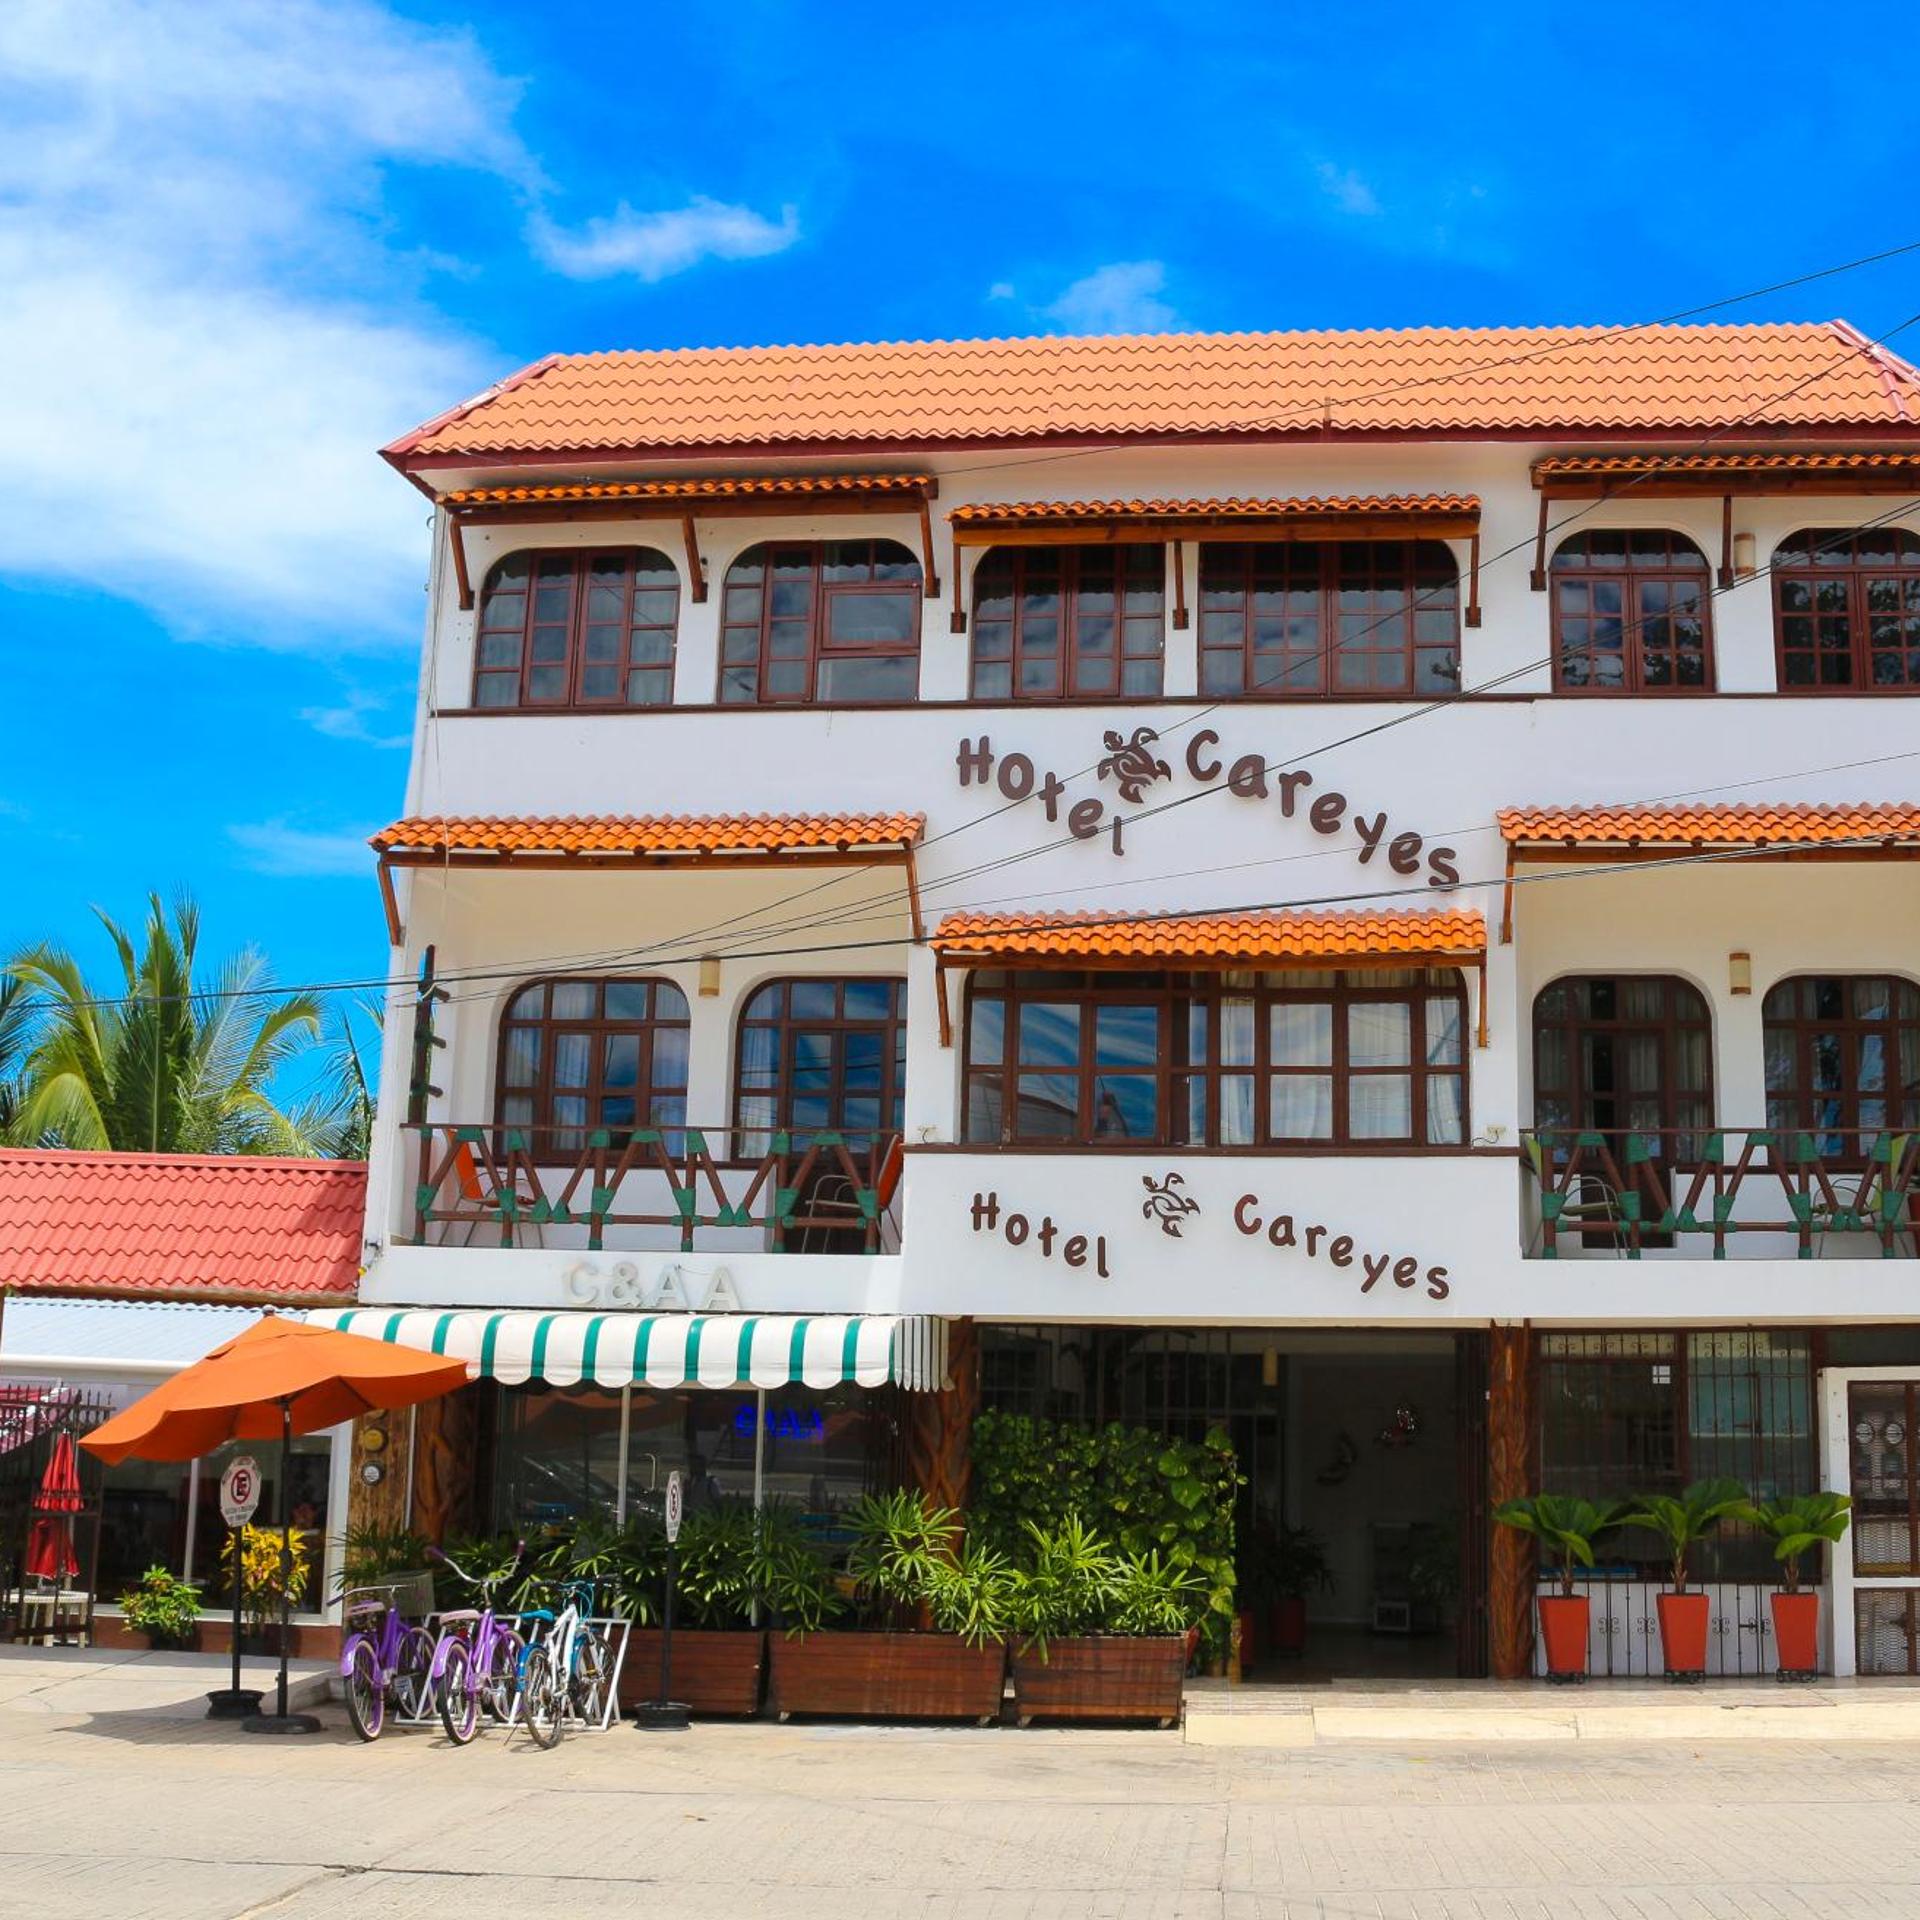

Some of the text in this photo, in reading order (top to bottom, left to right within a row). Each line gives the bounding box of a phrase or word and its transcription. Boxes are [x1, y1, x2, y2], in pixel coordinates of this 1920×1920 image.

[957, 729, 1461, 889] Hotel Careyes
[970, 1192, 1451, 1301] Hotel Careyes
